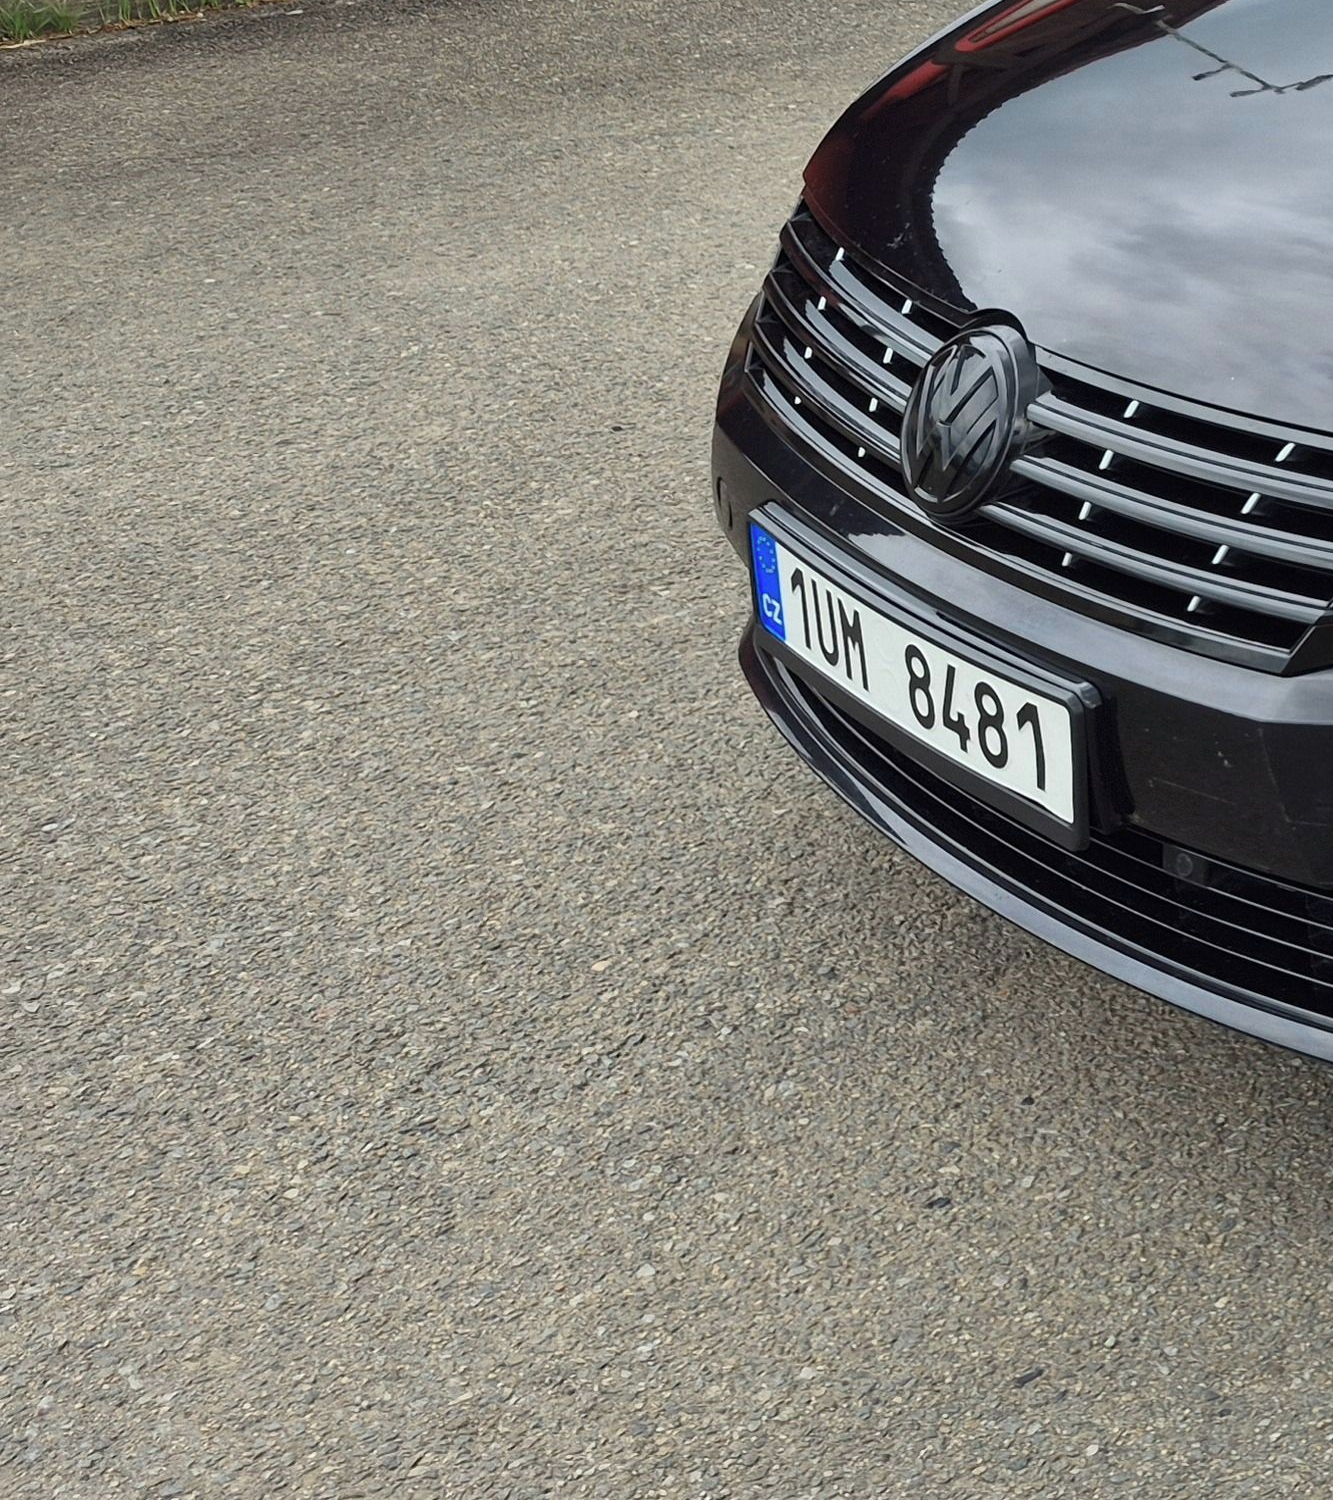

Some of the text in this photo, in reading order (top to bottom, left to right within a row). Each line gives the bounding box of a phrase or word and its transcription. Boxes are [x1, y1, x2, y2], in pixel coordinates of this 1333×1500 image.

[761, 592, 783, 626] CZ
[790, 567, 1047, 792] 1UM 8481
